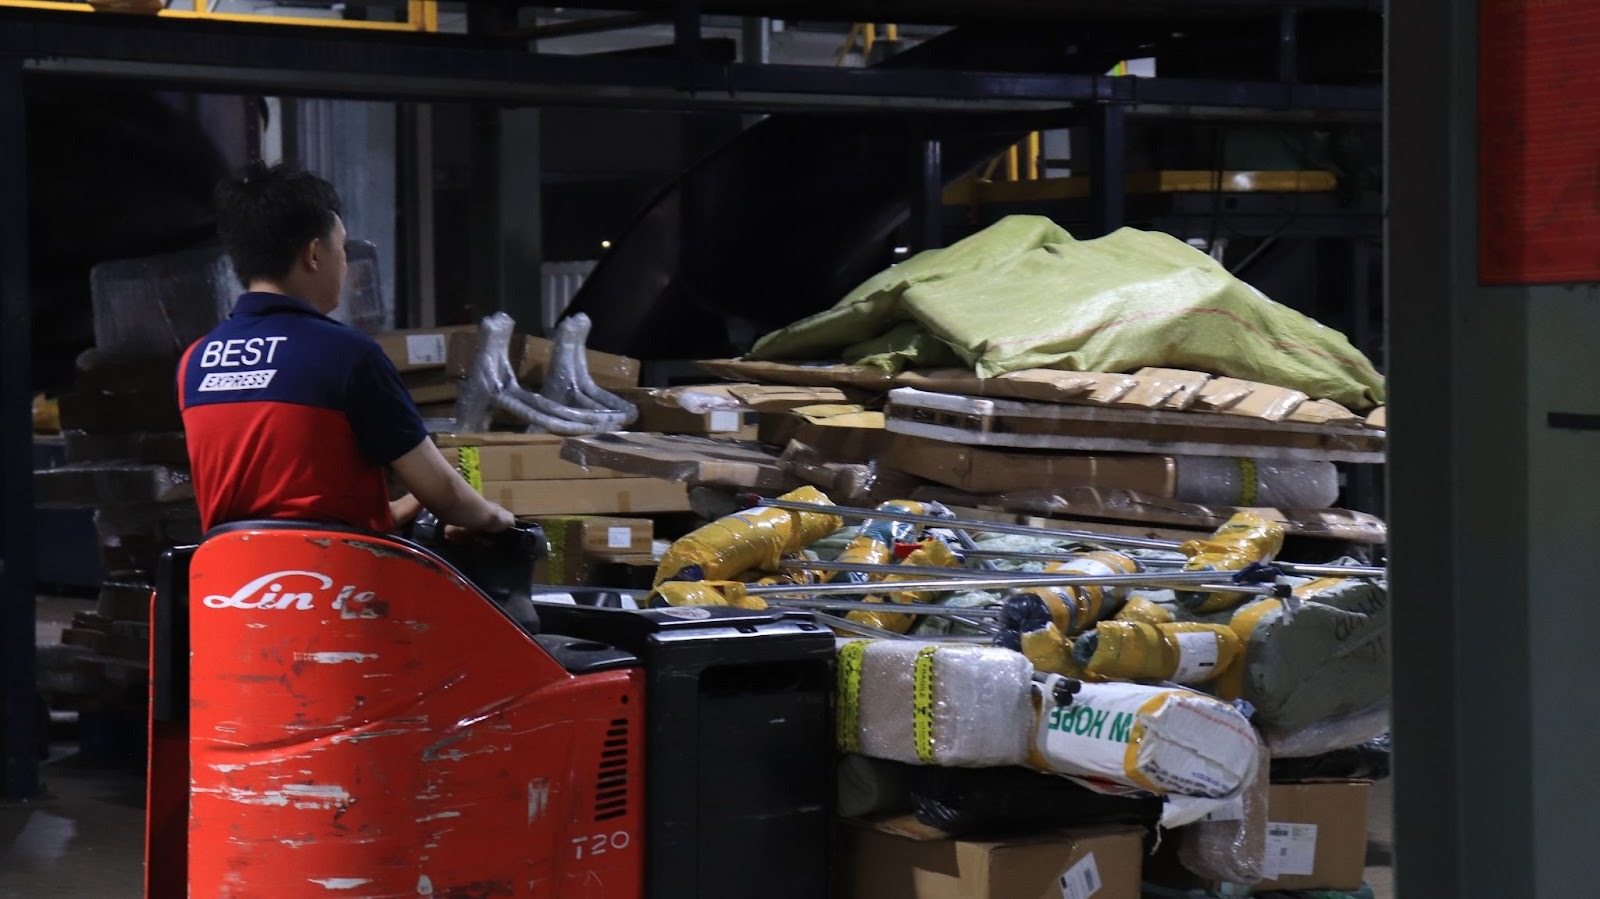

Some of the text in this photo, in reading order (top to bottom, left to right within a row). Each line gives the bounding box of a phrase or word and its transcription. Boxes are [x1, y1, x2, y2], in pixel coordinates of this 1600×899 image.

[200, 336, 288, 368] BEST
[204, 371, 271, 389] EXPRESS
[571, 830, 630, 860] T20
